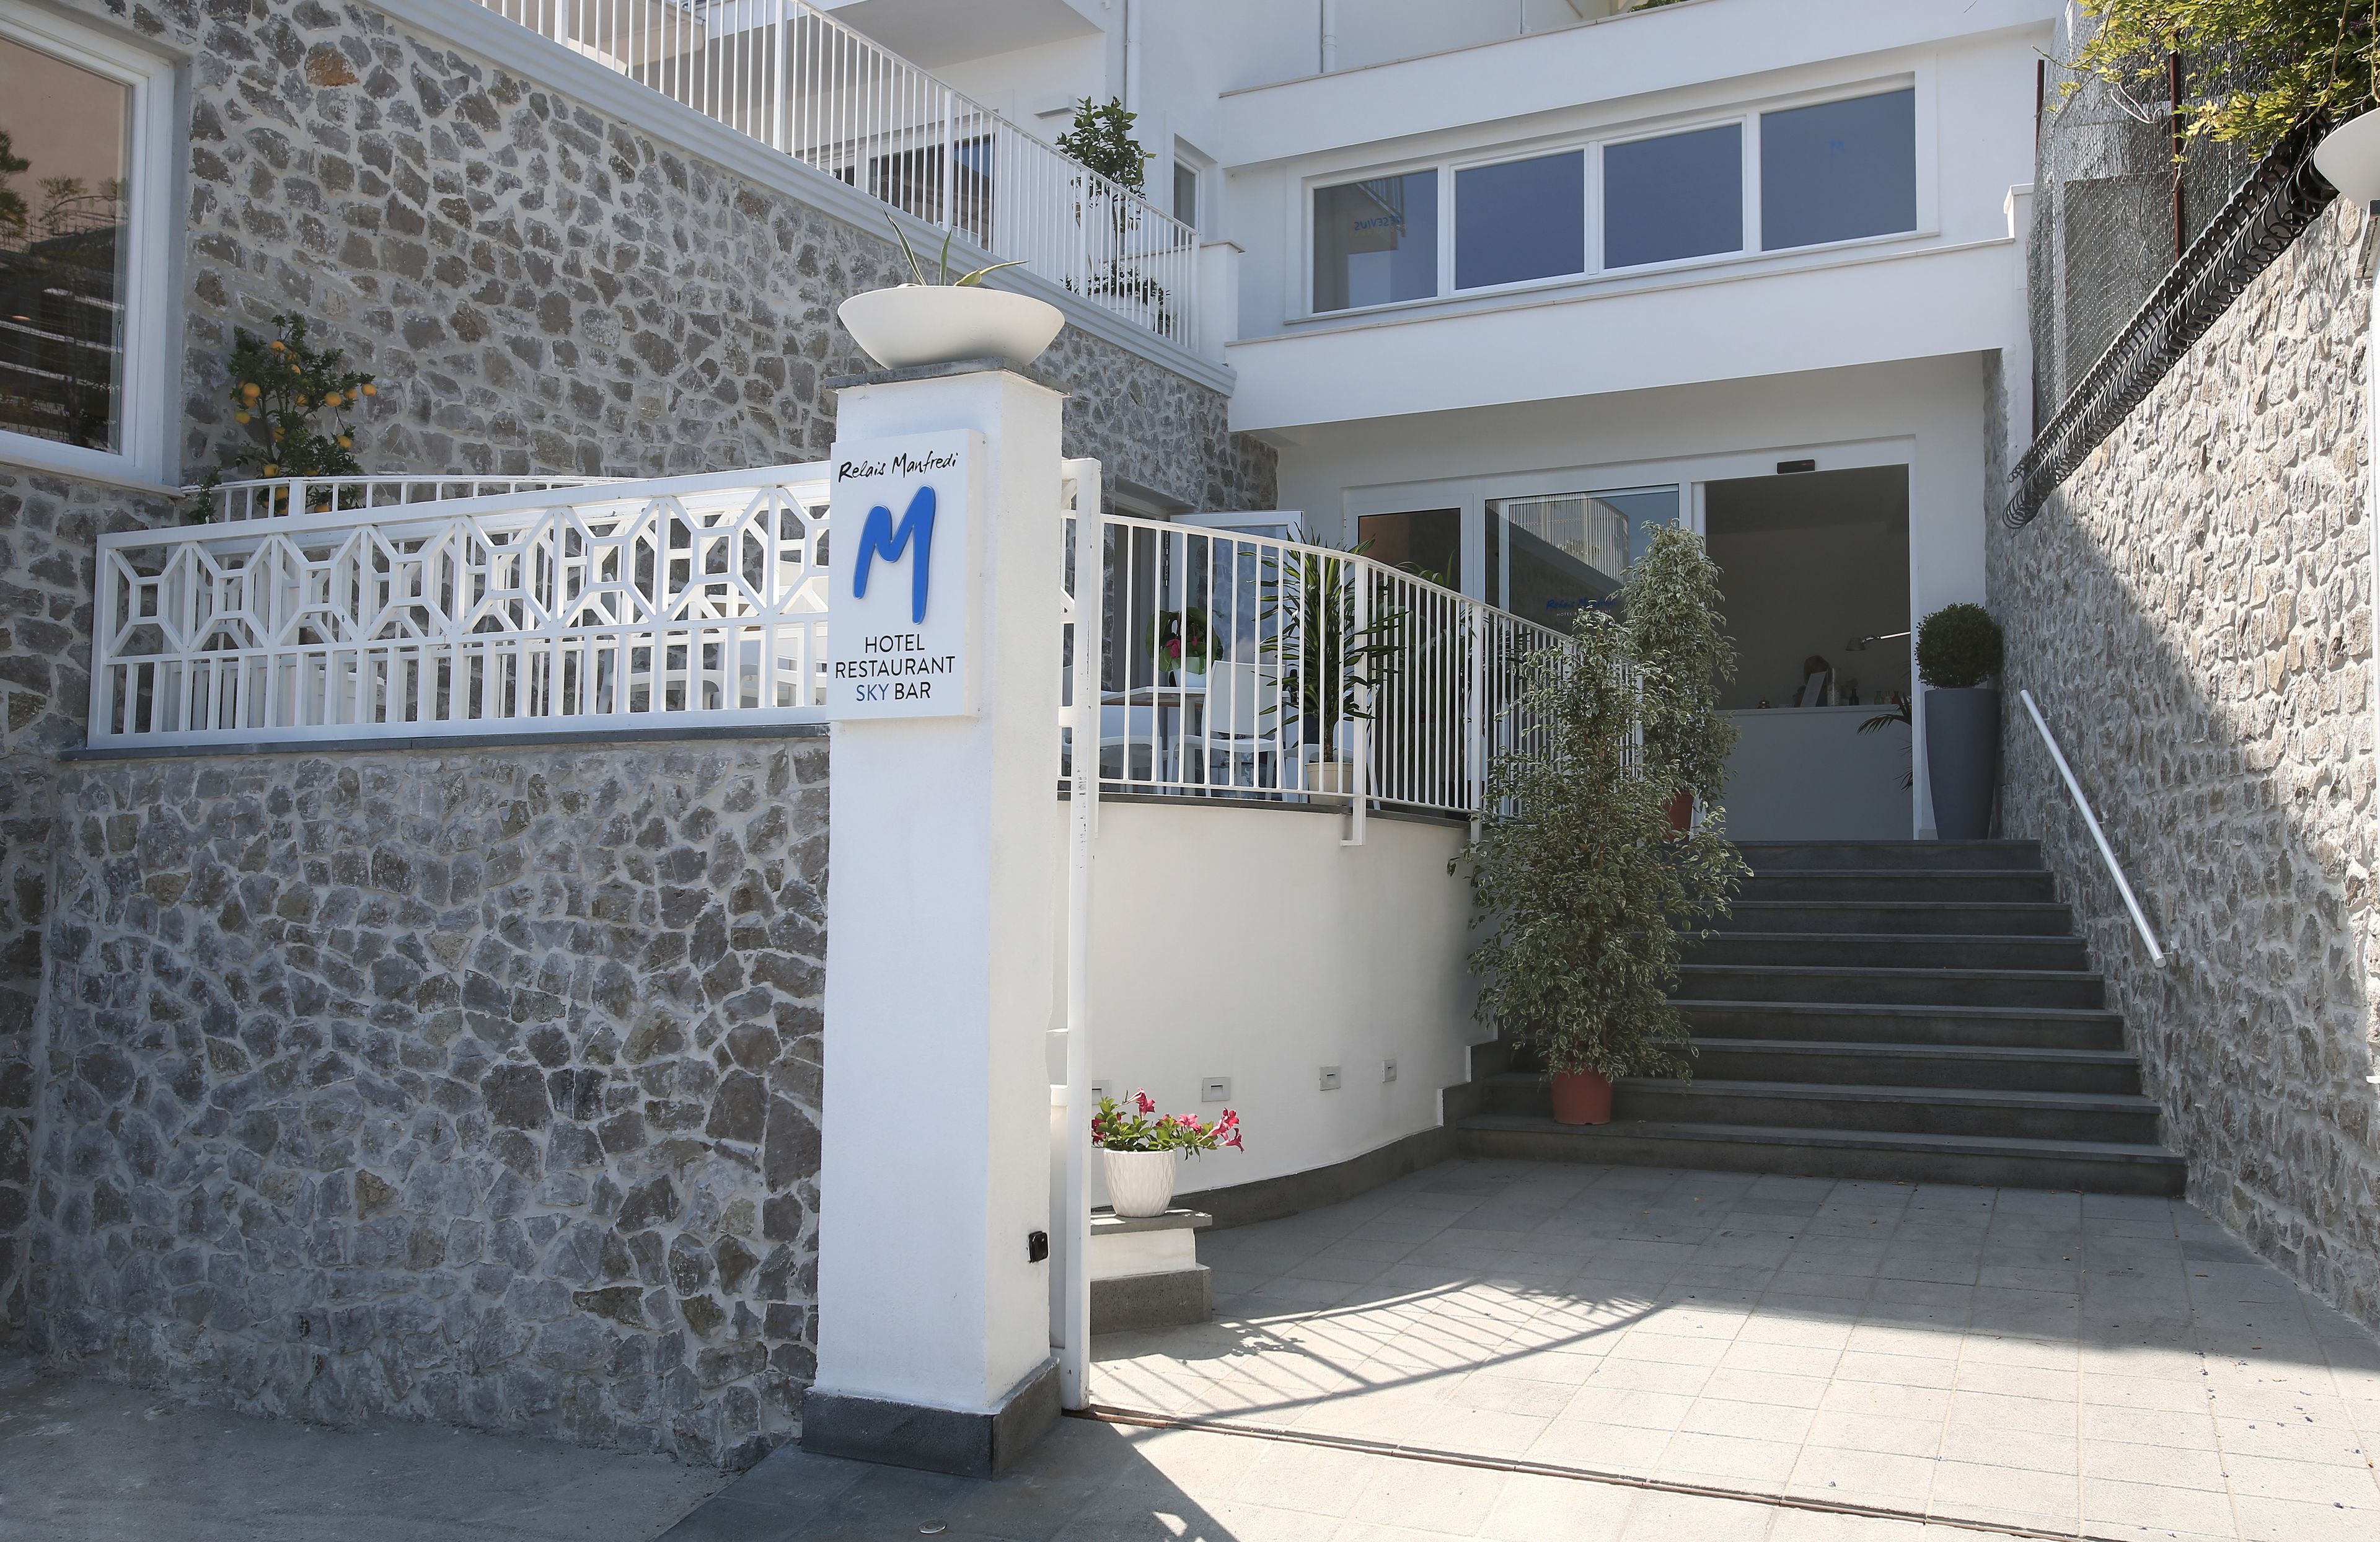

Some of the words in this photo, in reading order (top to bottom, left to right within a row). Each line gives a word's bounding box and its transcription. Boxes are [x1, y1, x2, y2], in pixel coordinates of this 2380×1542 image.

[838, 460, 886, 483] Relais
[892, 450, 959, 478] Manfredi
[852, 484, 937, 625] M
[865, 633, 925, 653] HOTEL
[835, 656, 956, 679] RESTAURANT
[856, 683, 889, 702] SKY
[895, 681, 931, 700] BAR
